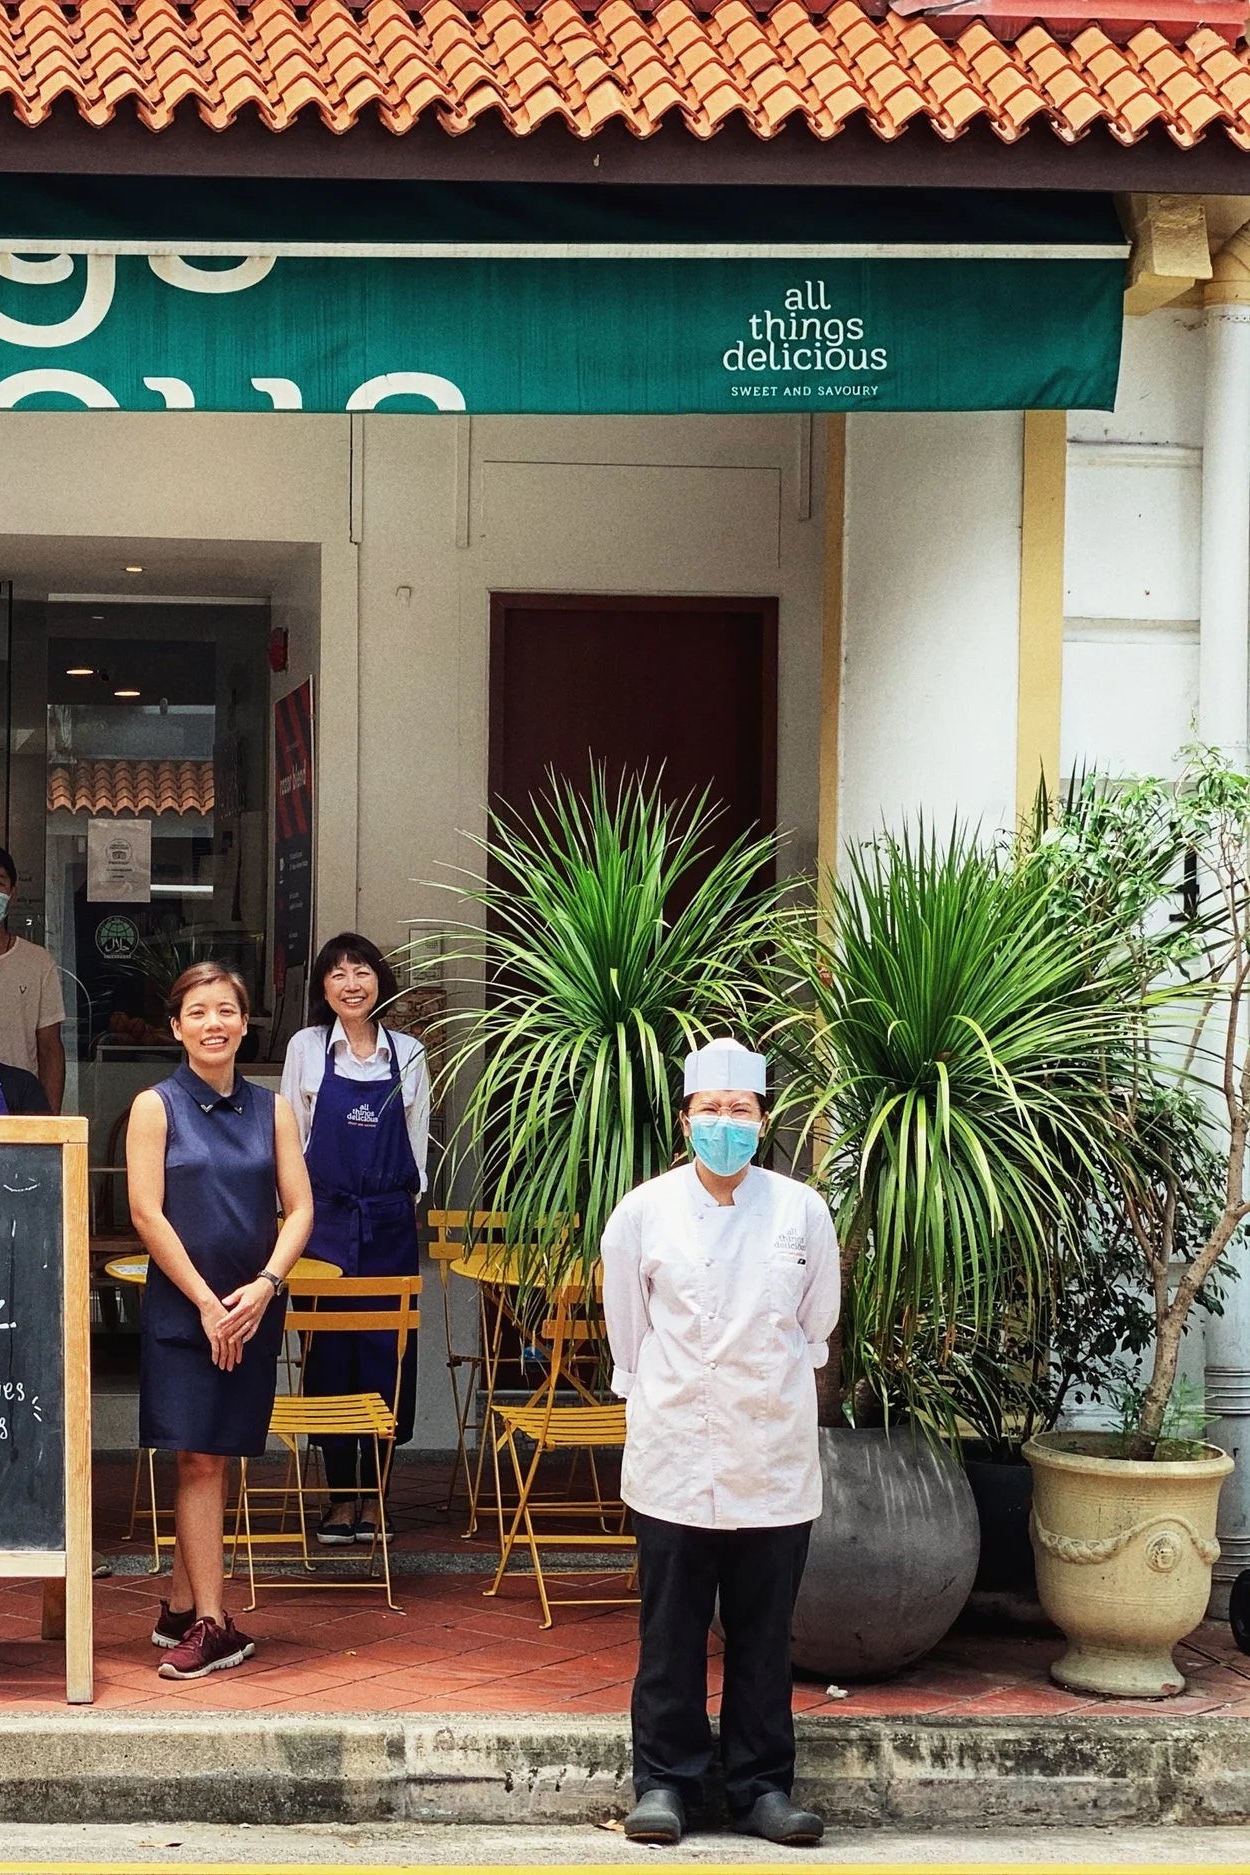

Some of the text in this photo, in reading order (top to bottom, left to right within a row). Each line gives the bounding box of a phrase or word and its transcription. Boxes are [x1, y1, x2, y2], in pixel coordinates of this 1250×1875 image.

[784, 280, 831, 310] all
[749, 310, 864, 347] things
[722, 340, 888, 371] delicious
[731, 385, 879, 397] SWEET AND SAVOURY
